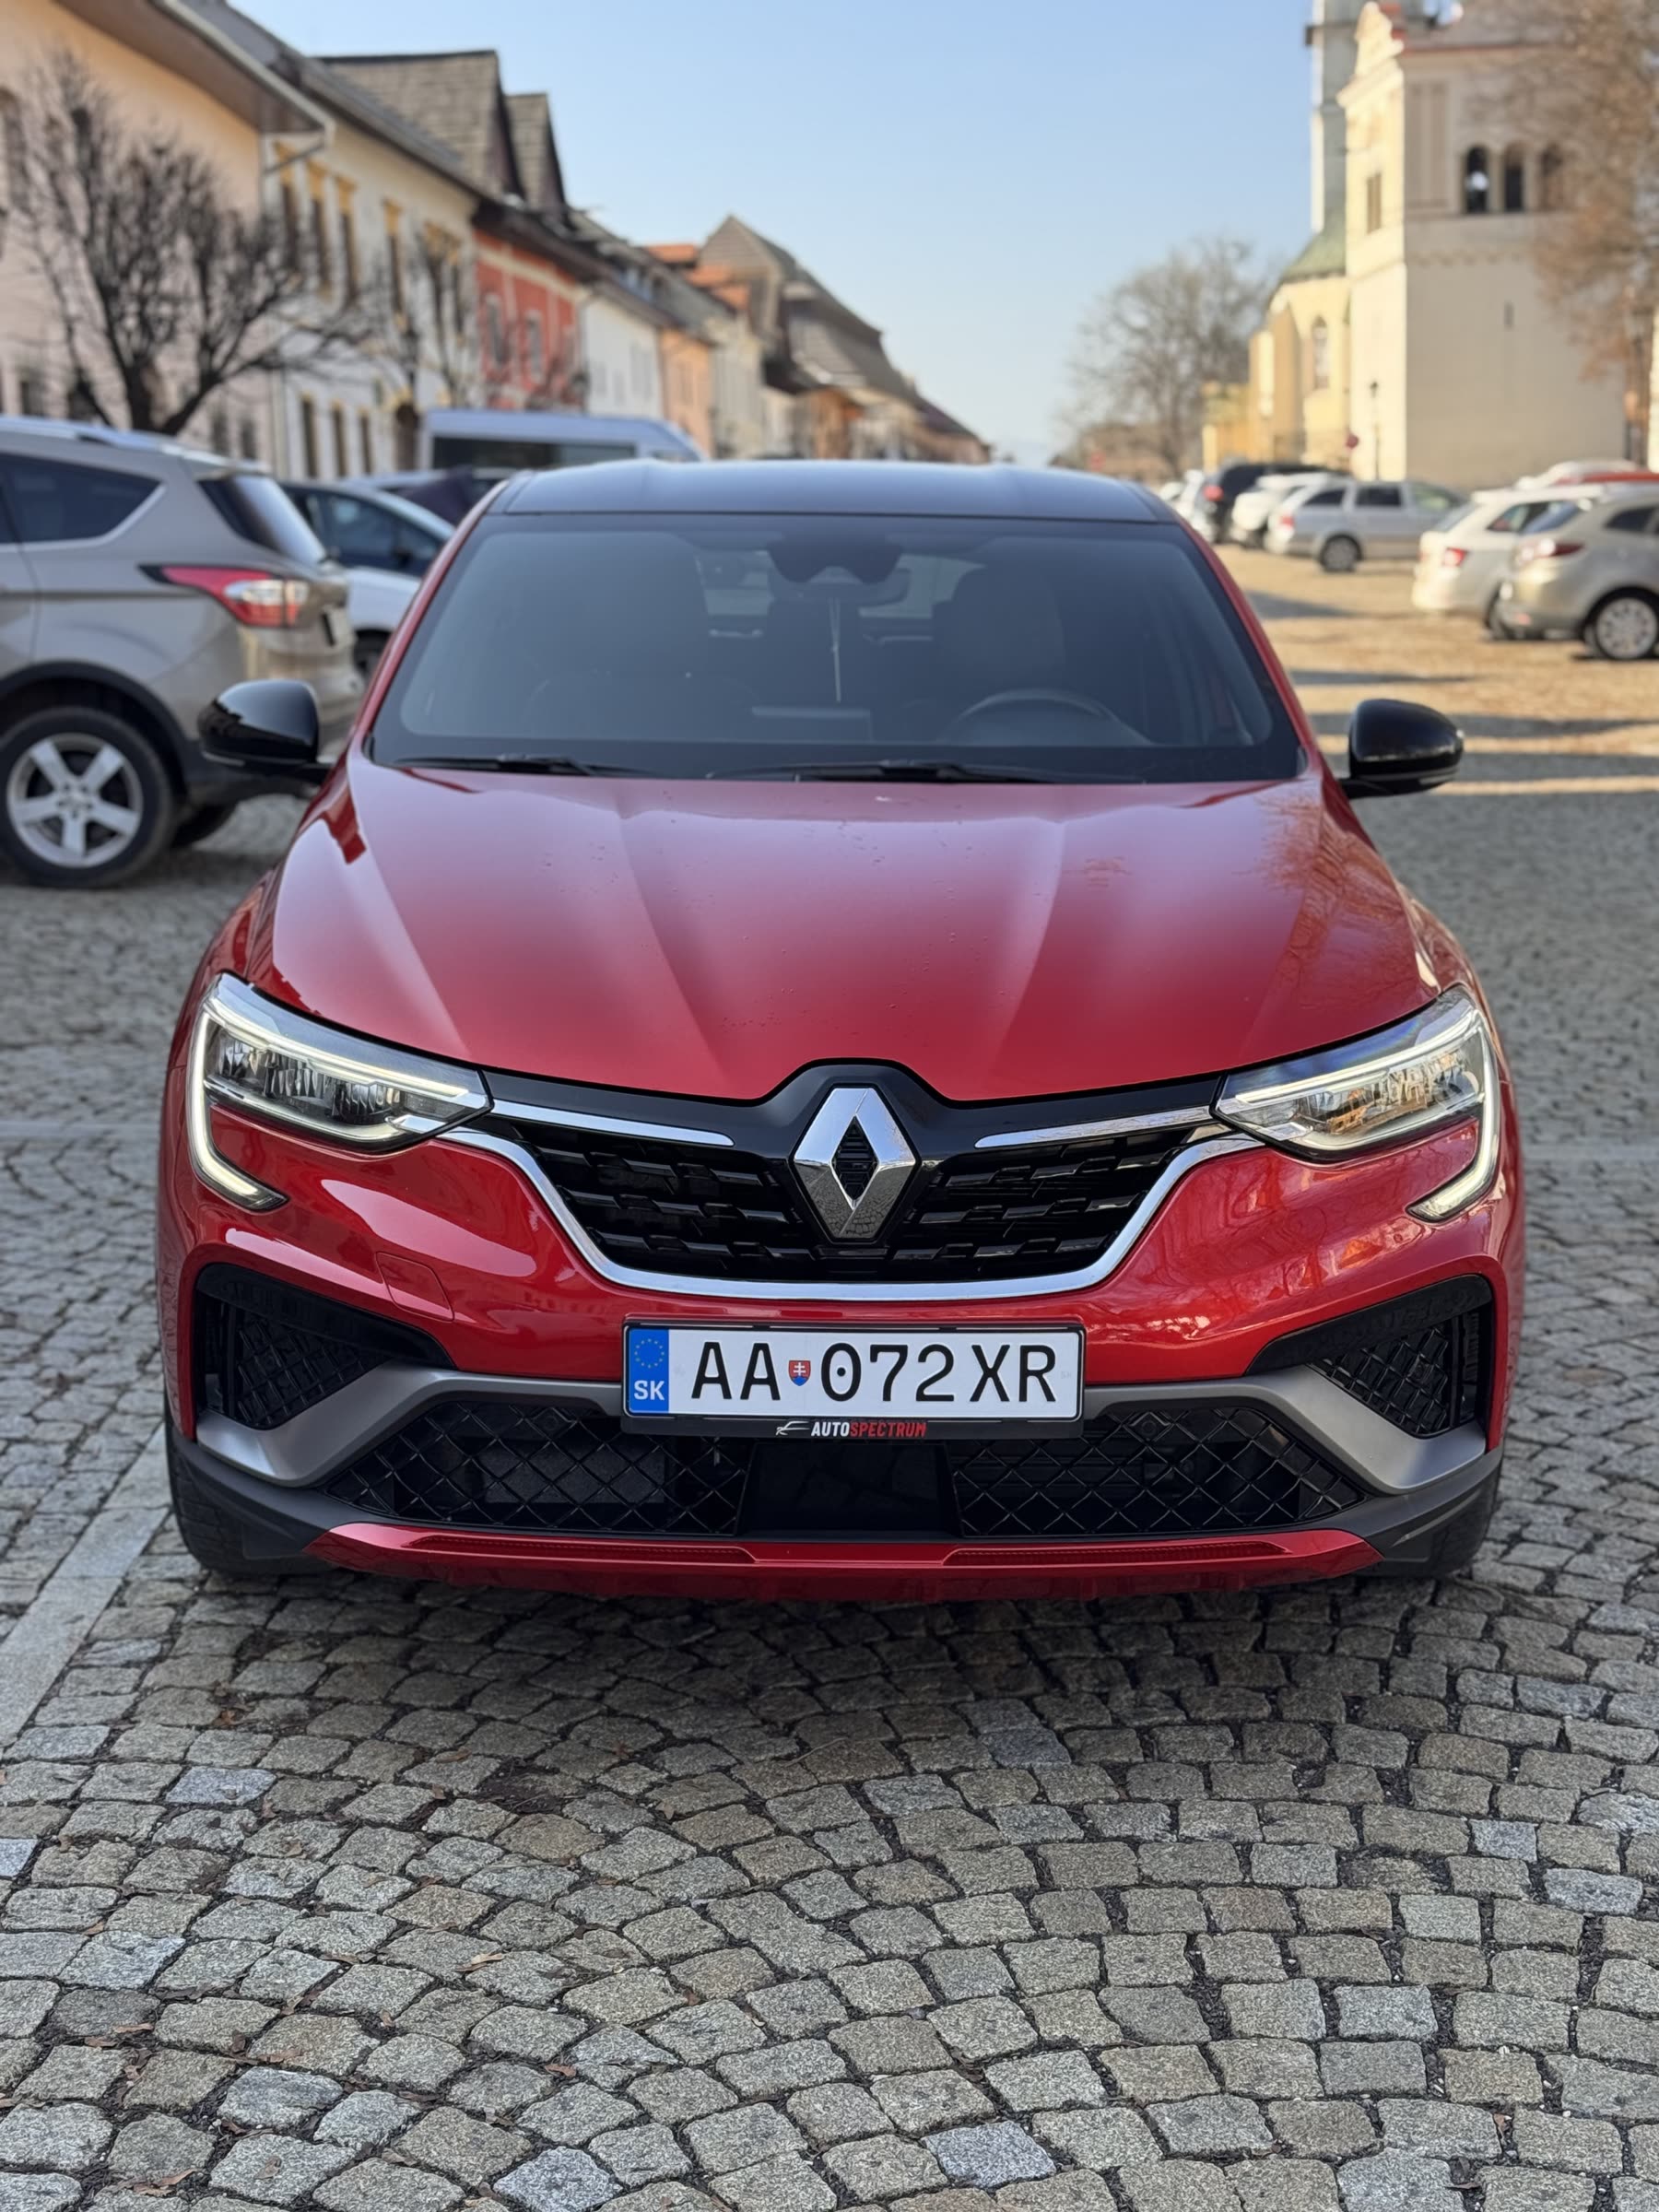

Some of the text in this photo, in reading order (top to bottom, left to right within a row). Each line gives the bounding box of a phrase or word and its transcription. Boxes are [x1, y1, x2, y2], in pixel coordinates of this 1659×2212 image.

[691, 1341, 781, 1400] AA
[633, 1380, 665, 1401] SK
[810, 1421, 926, 1438] AUTOSPECTRUM
